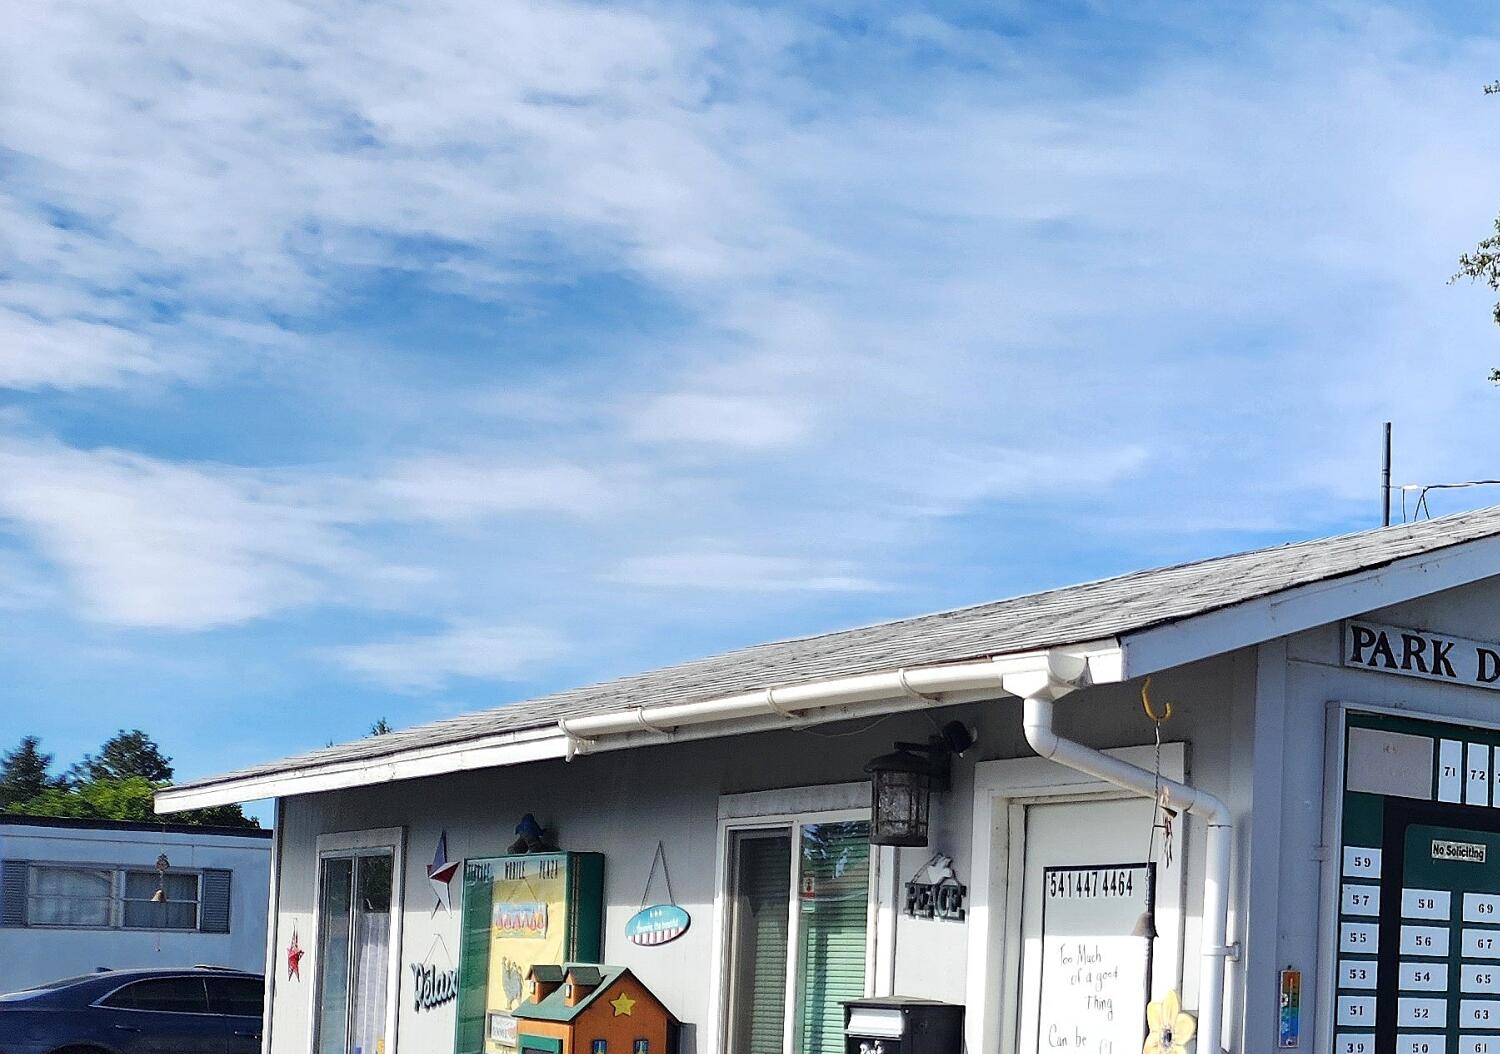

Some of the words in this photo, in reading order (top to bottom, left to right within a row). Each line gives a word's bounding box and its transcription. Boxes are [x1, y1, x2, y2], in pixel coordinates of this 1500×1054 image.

[1350, 624, 1457, 678] PARK
[1444, 766, 1456, 777] 71
[1470, 769, 1486, 781] 72
[1433, 844, 1444, 855] No
[1446, 845, 1484, 861] Soliciting
[1354, 856, 1371, 868] 59
[1050, 872, 1072, 898] 541
[1076, 871, 1098, 898] 447
[1103, 870, 1133, 897] 4464
[1352, 894, 1370, 906] 57
[1418, 898, 1434, 909] 58
[1478, 903, 1494, 914] 69
[1349, 932, 1367, 943] 55
[1415, 935, 1432, 947] 56
[1477, 938, 1493, 950] 67
[1077, 944, 1102, 966] Much
[1095, 966, 1118, 992] good
[1349, 968, 1366, 980] 53
[1414, 971, 1431, 982] 54
[1475, 973, 1492, 984] 65
[1349, 1005, 1363, 1016] 51
[1414, 1007, 1429, 1019] 52
[1474, 1009, 1489, 1020] 63
[1049, 1024, 1068, 1047] Can
[1076, 1026, 1087, 1047] be
[1346, 1042, 1365, 1054] 39
[1412, 1043, 1429, 1054] 50
[1474, 1042, 1487, 1054] 61
